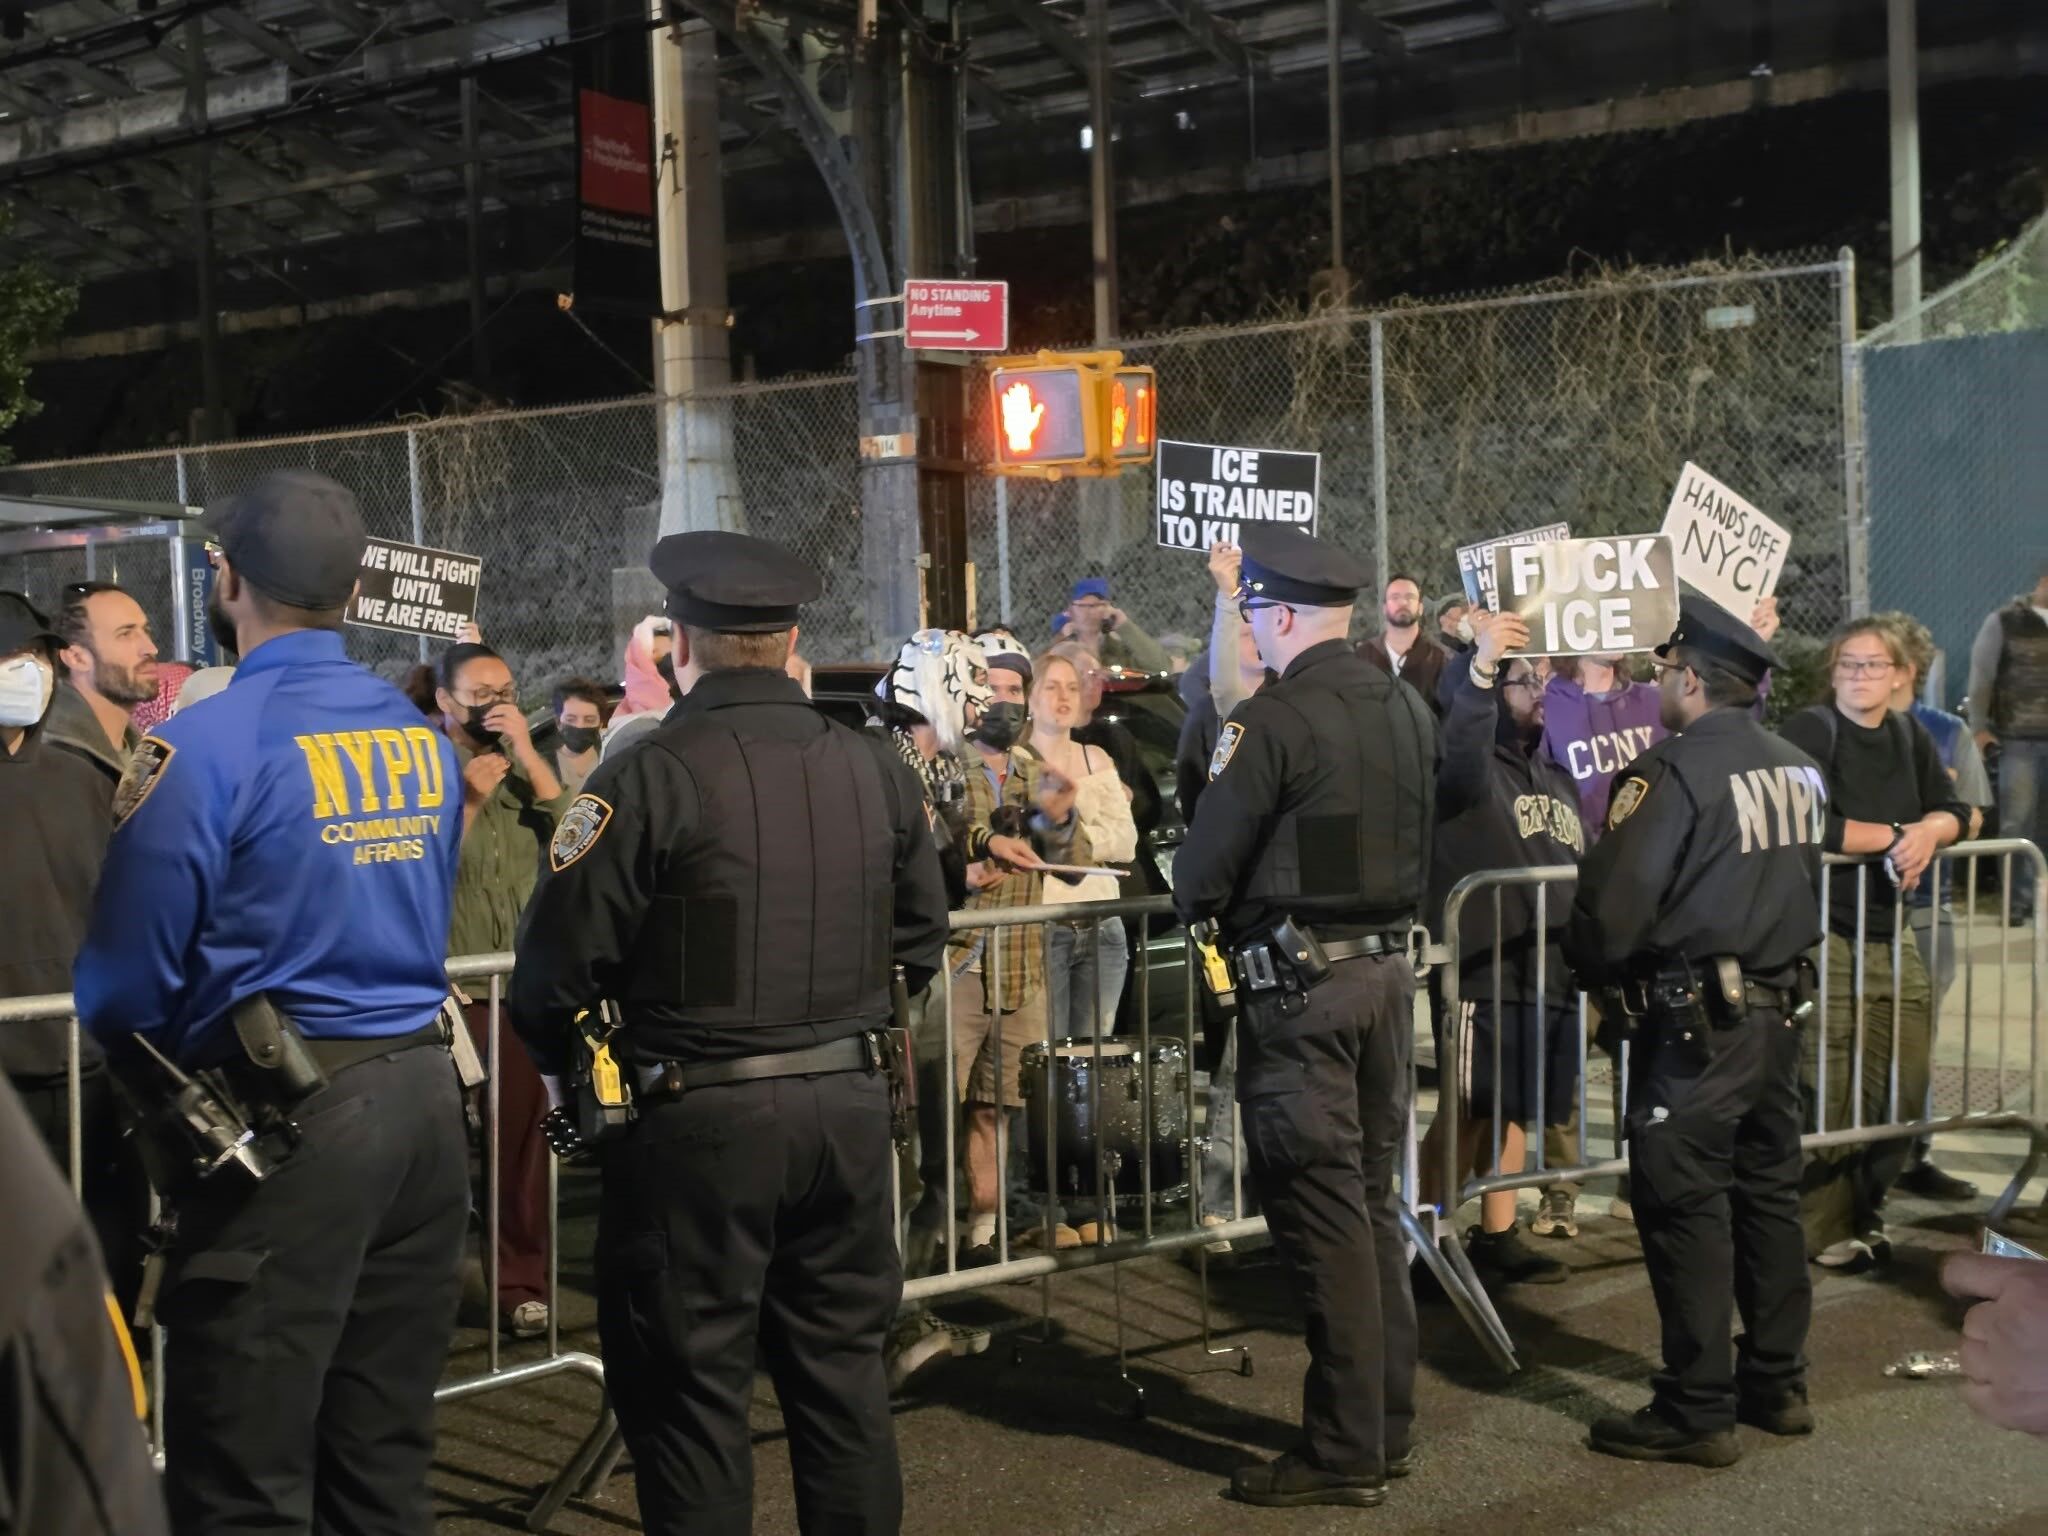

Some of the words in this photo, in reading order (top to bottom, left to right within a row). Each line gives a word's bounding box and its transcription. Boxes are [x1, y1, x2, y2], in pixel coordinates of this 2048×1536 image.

[910, 289, 928, 301] NO
[931, 289, 991, 302] STANDING
[911, 303, 962, 319] Anytime
[1212, 449, 1259, 483] ICE
[1161, 478, 1186, 512] IS
[1190, 482, 1313, 522] TRAINED
[1683, 477, 1748, 539] HANDS
[1748, 524, 1781, 561] OFF
[1162, 514, 1197, 547] TO
[389, 550, 430, 578] WILL
[432, 558, 480, 586] FIGHT
[1510, 538, 1660, 596] FUCK
[1682, 519, 1770, 605] NYC!
[192, 568, 207, 654] Broadway
[392, 577, 443, 606] UNTIL
[357, 596, 386, 622] WE
[385, 603, 423, 628] ARE
[422, 609, 468, 634] FREE
[1544, 598, 1634, 652] ICE
[294, 727, 444, 819] NYPD
[1567, 726, 1652, 779] CCNY
[321, 815, 440, 844] COMMUNITY
[1730, 766, 1826, 853] NYPD
[354, 838, 424, 865] AFFAIRS
